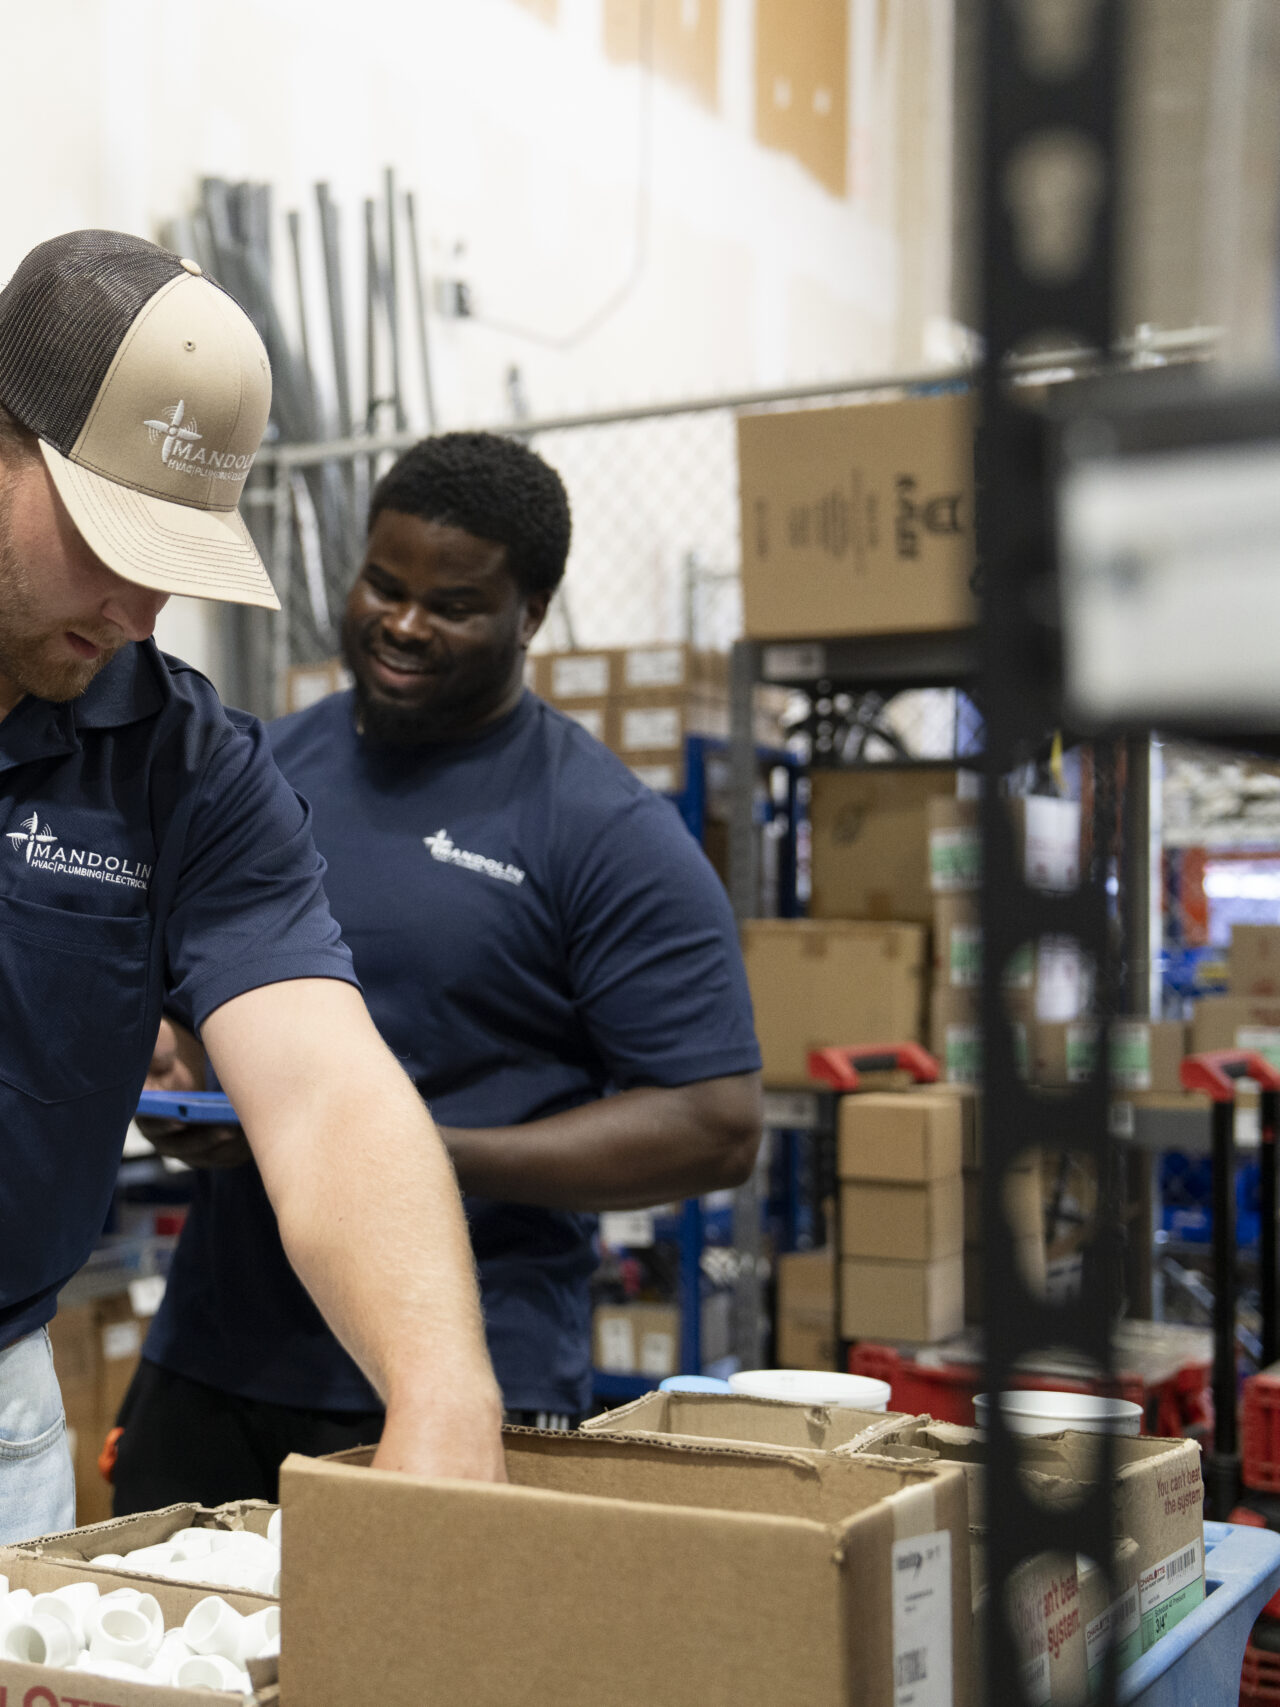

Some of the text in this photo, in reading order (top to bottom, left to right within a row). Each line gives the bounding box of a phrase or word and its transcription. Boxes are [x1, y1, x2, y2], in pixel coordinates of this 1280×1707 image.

[34, 844, 152, 879] MANDOLIN
[1156, 1477, 1169, 1498] You
[1170, 1469, 1187, 1493] can't
[1164, 1495, 1177, 1516] the
